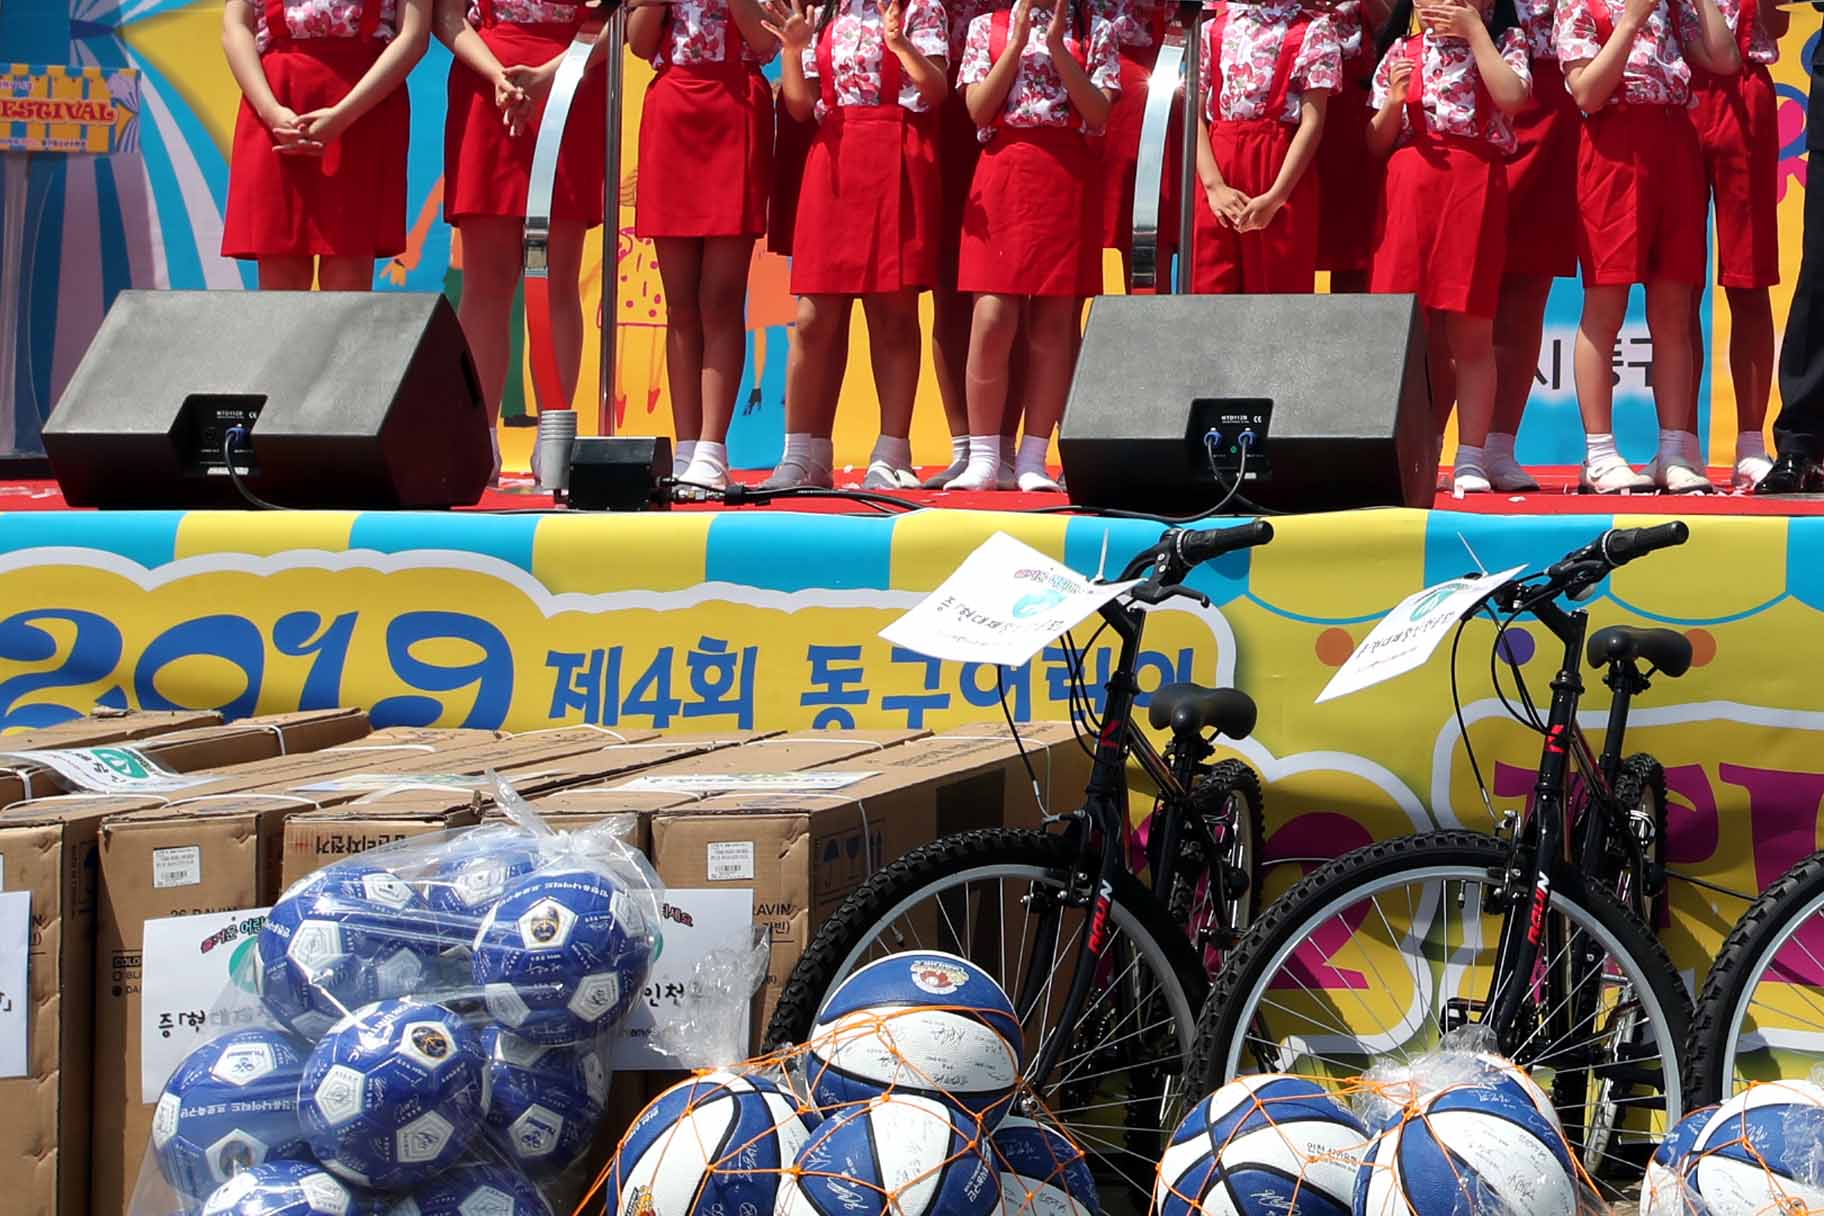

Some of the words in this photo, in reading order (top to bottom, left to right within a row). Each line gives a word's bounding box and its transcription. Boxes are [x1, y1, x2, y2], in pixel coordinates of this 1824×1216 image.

[0, 608, 516, 731] 2019
[546, 635, 758, 731] 제4회
[315, 834, 408, 854] 리자전거
[753, 903, 794, 916] AVIN
[115, 957, 142, 967] COLO
